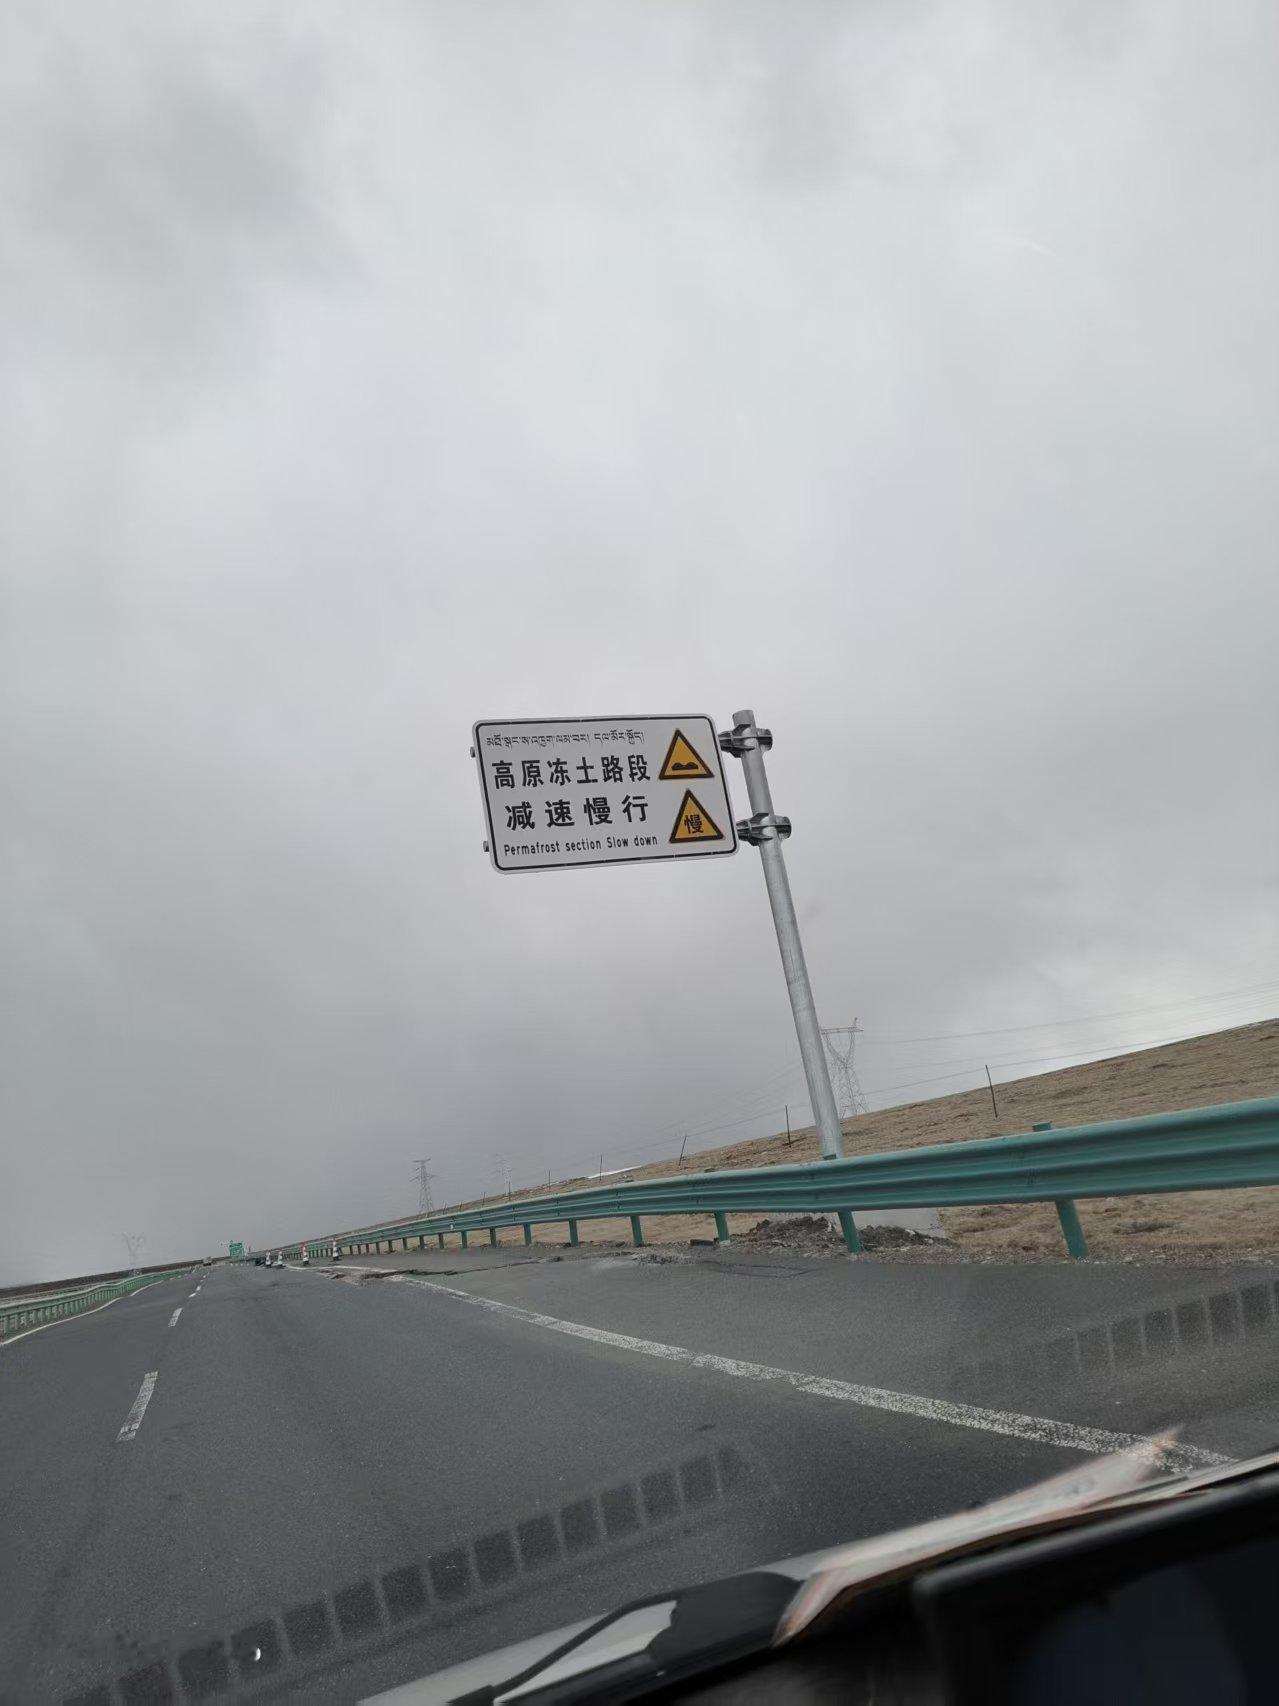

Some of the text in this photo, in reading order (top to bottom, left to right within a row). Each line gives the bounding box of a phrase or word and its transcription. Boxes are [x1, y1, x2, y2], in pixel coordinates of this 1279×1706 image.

[491, 755, 650, 789] 高原冻土路段
[505, 795, 649, 831] 减速慢行
[684, 814, 704, 834] 慢
[504, 834, 658, 856] Permafrost section Slow down
